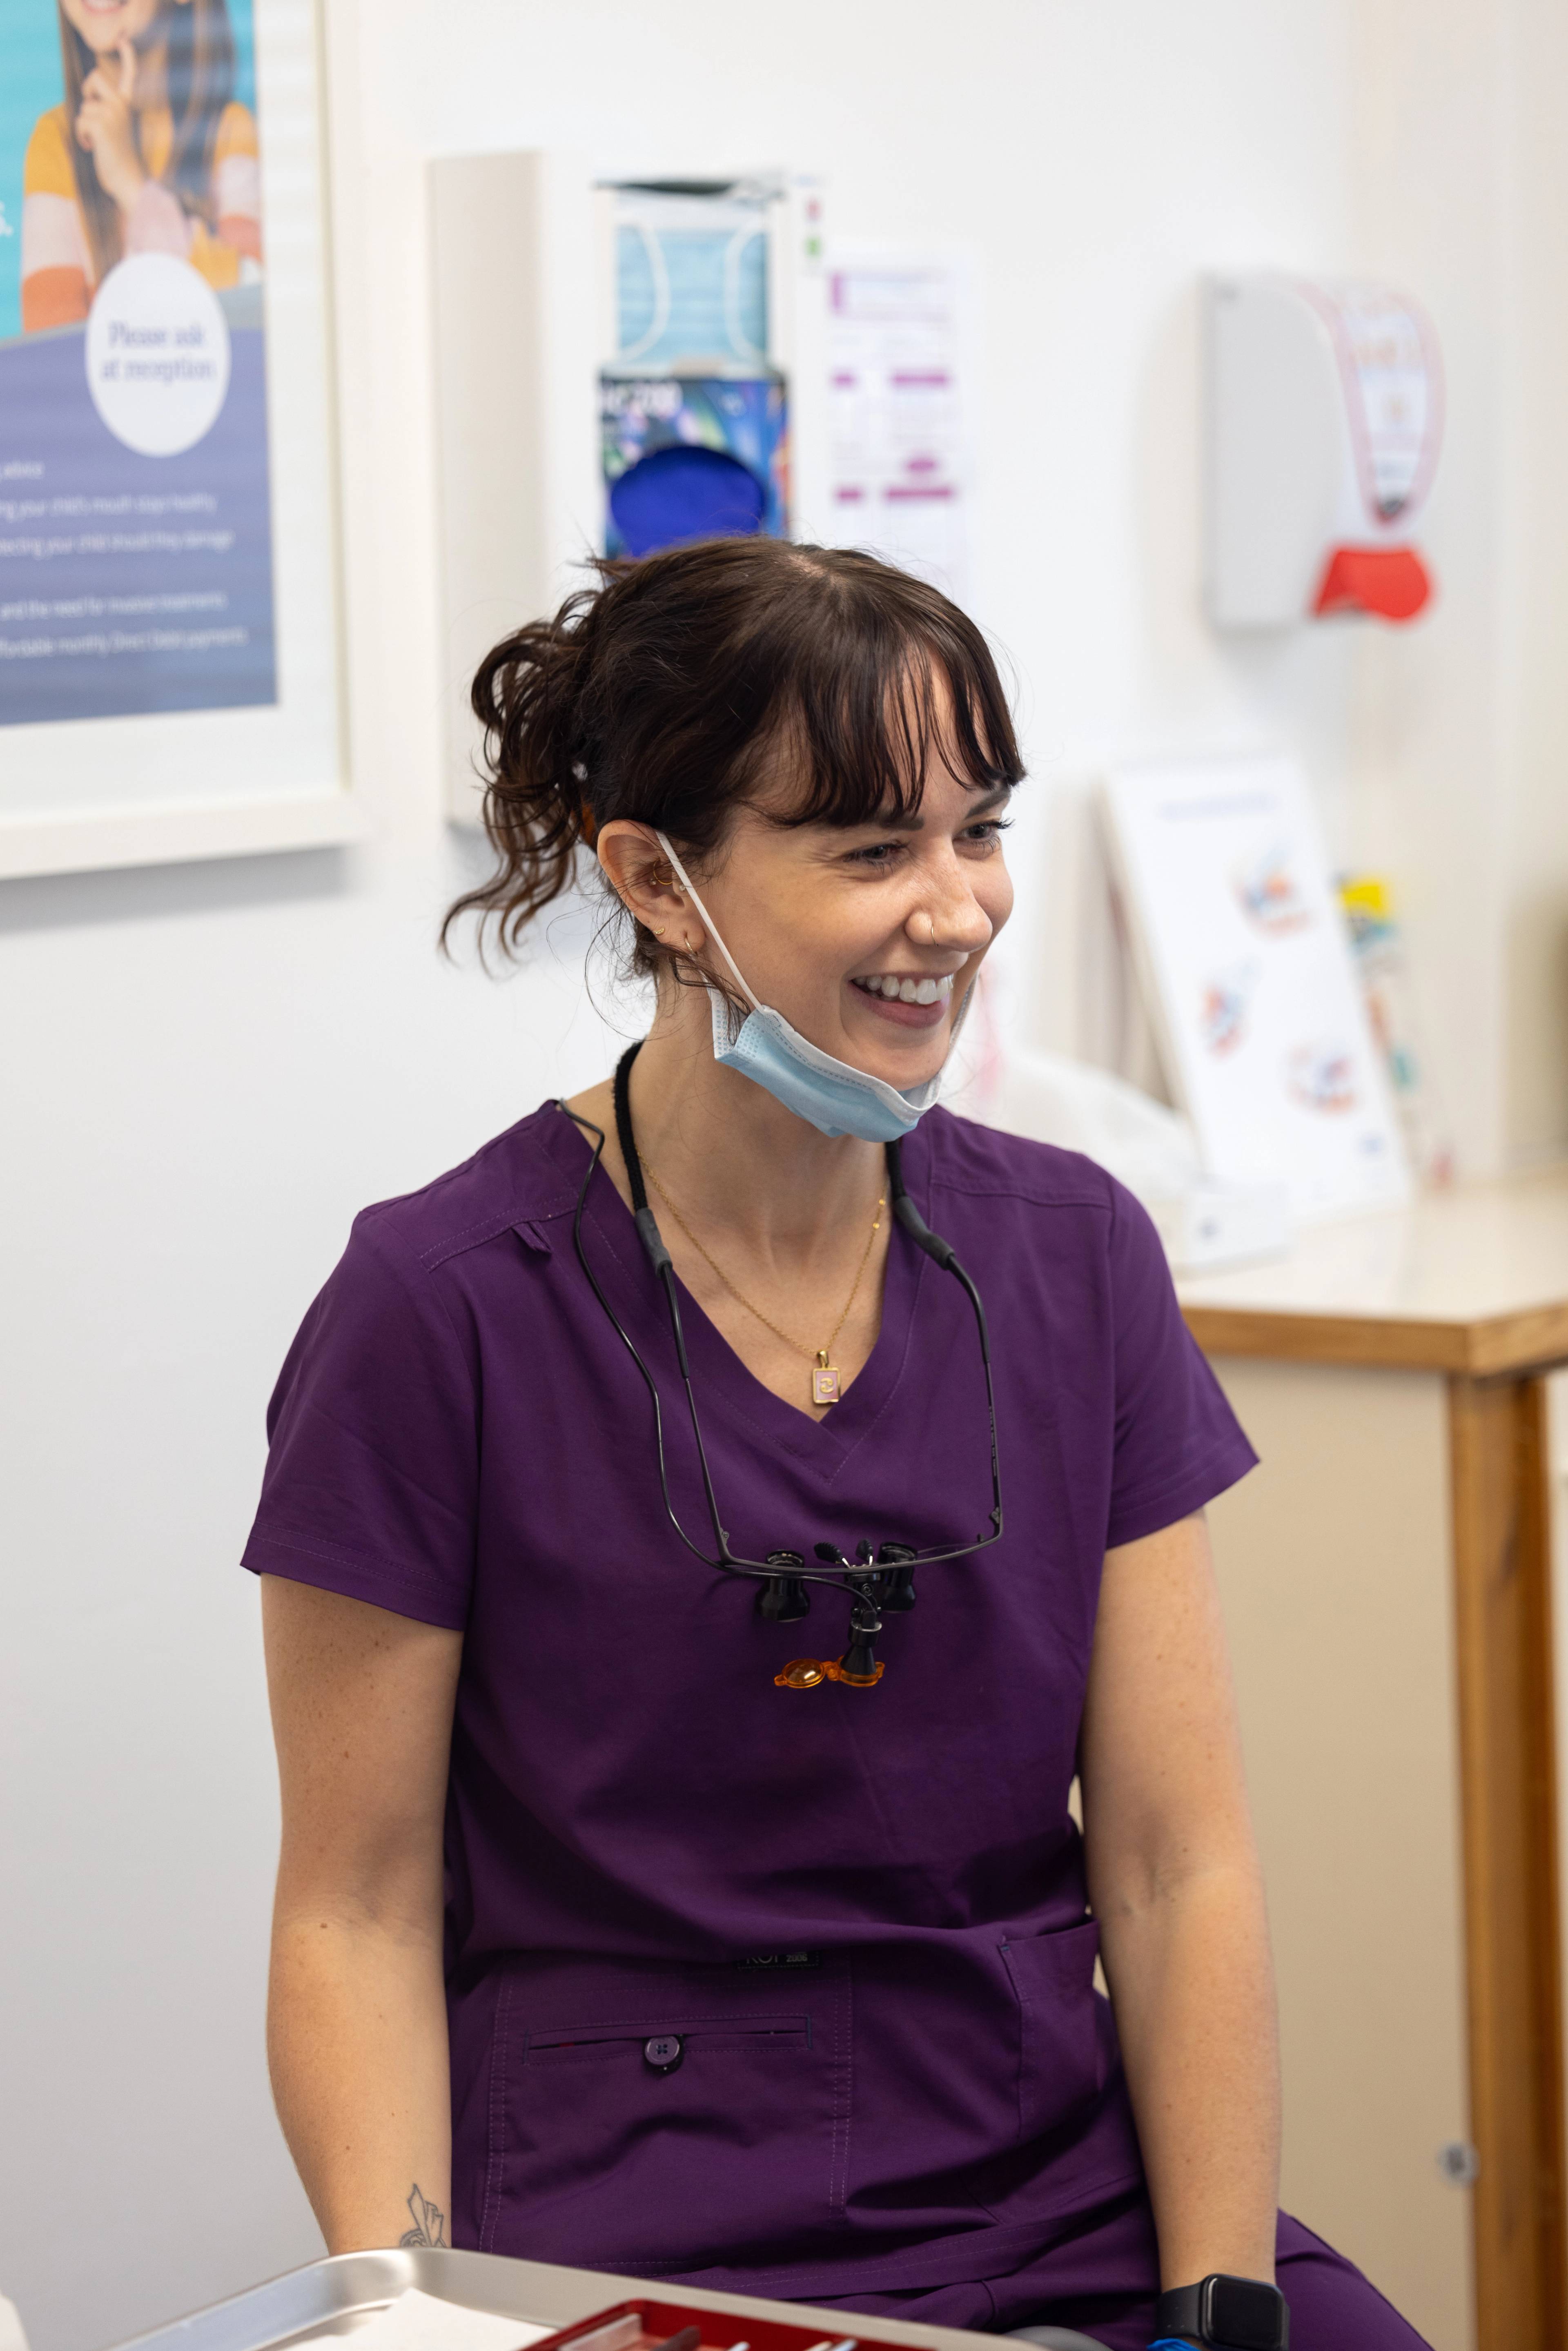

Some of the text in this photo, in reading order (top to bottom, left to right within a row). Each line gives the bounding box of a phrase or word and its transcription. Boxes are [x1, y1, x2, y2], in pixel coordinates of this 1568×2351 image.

[109, 321, 205, 347] Please ask
[100, 355, 215, 385] at reception
[18, 500, 48, 519] your
[45, 537, 75, 557] your
